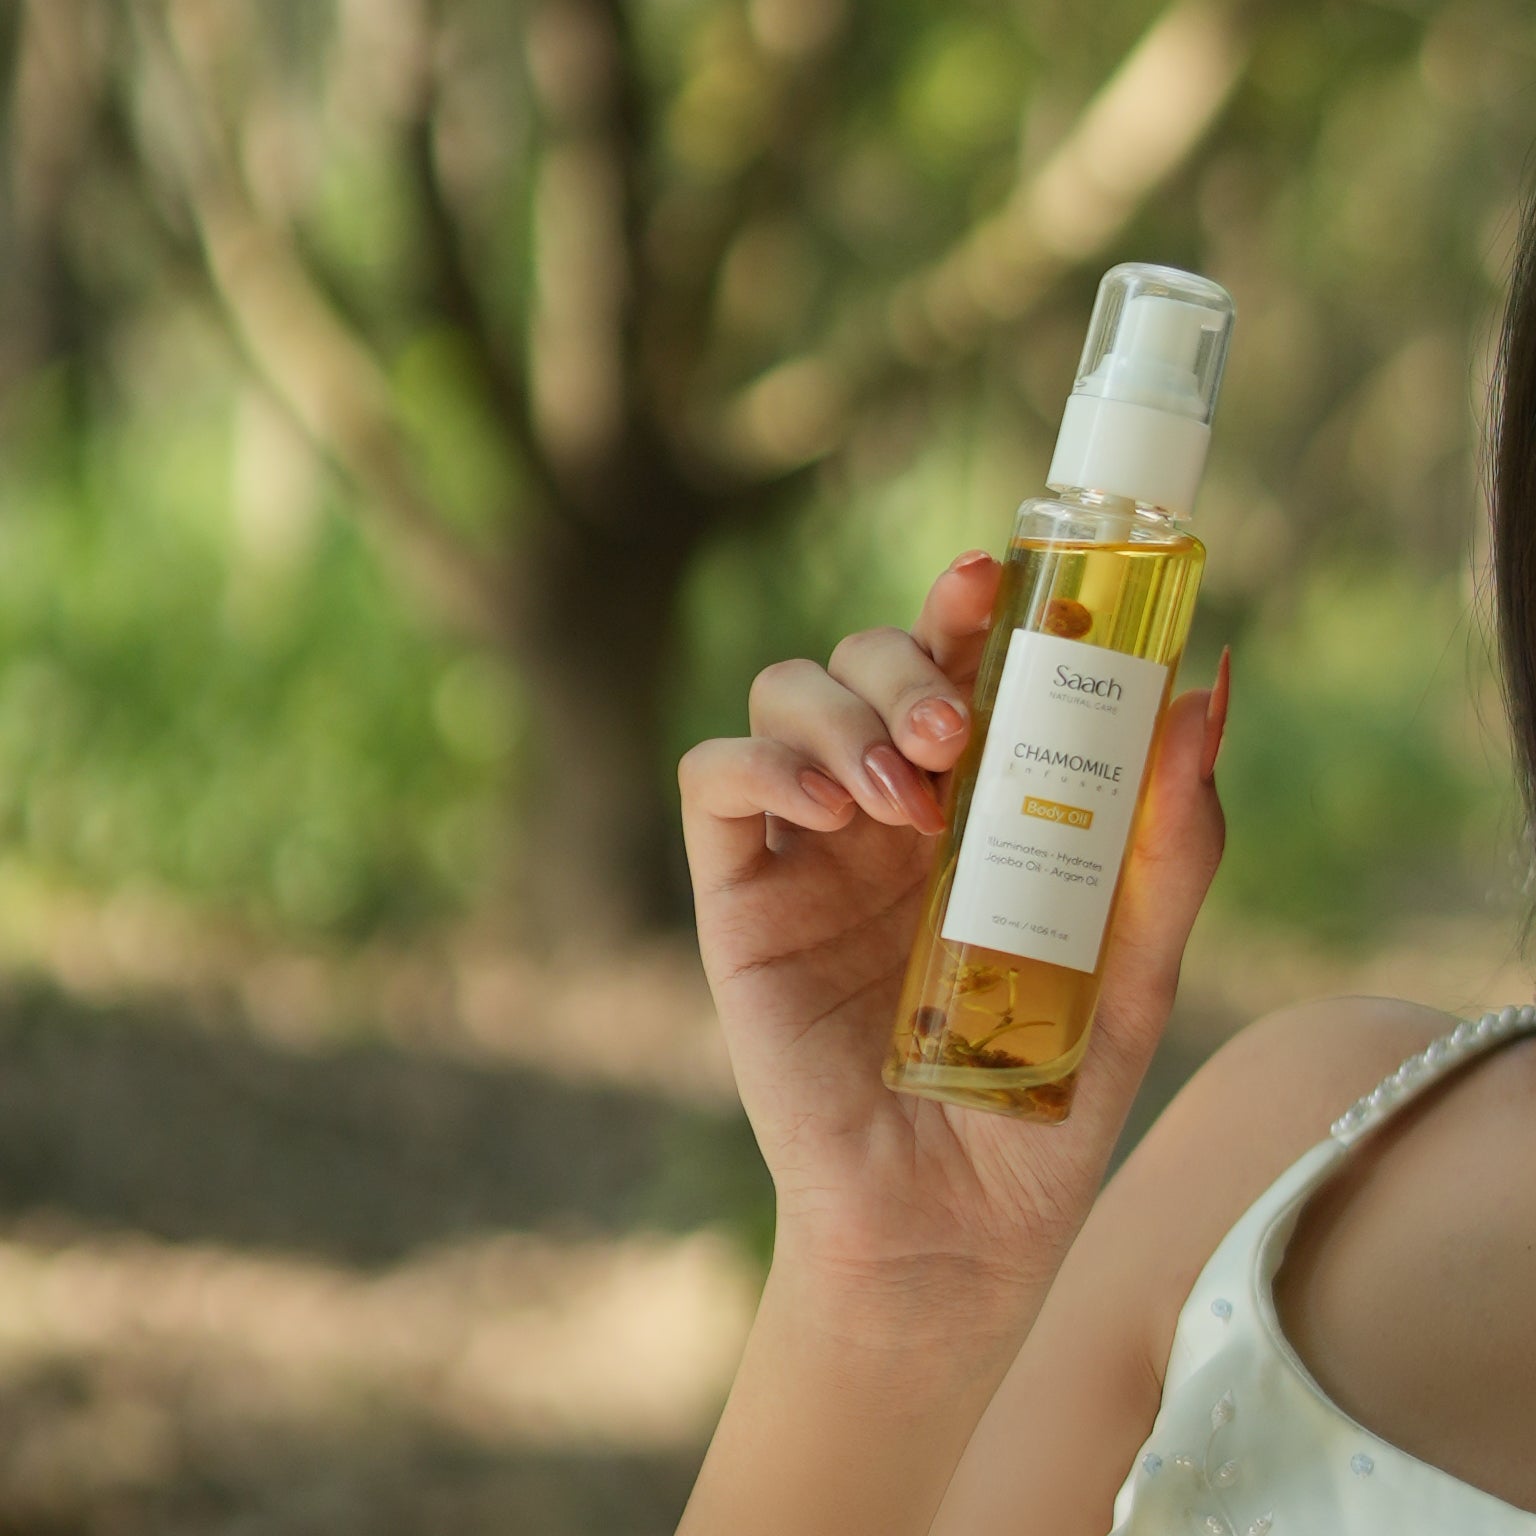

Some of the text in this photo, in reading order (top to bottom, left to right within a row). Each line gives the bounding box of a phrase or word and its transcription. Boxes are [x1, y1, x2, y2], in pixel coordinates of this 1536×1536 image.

[1053, 664, 1122, 701] Saach
[1049, 690, 1119, 716] NATURAL CARE
[1013, 742, 1123, 783] CHAMOMILE
[1027, 799, 1088, 825] Body Oil
[1025, 860, 1041, 873] Oil
